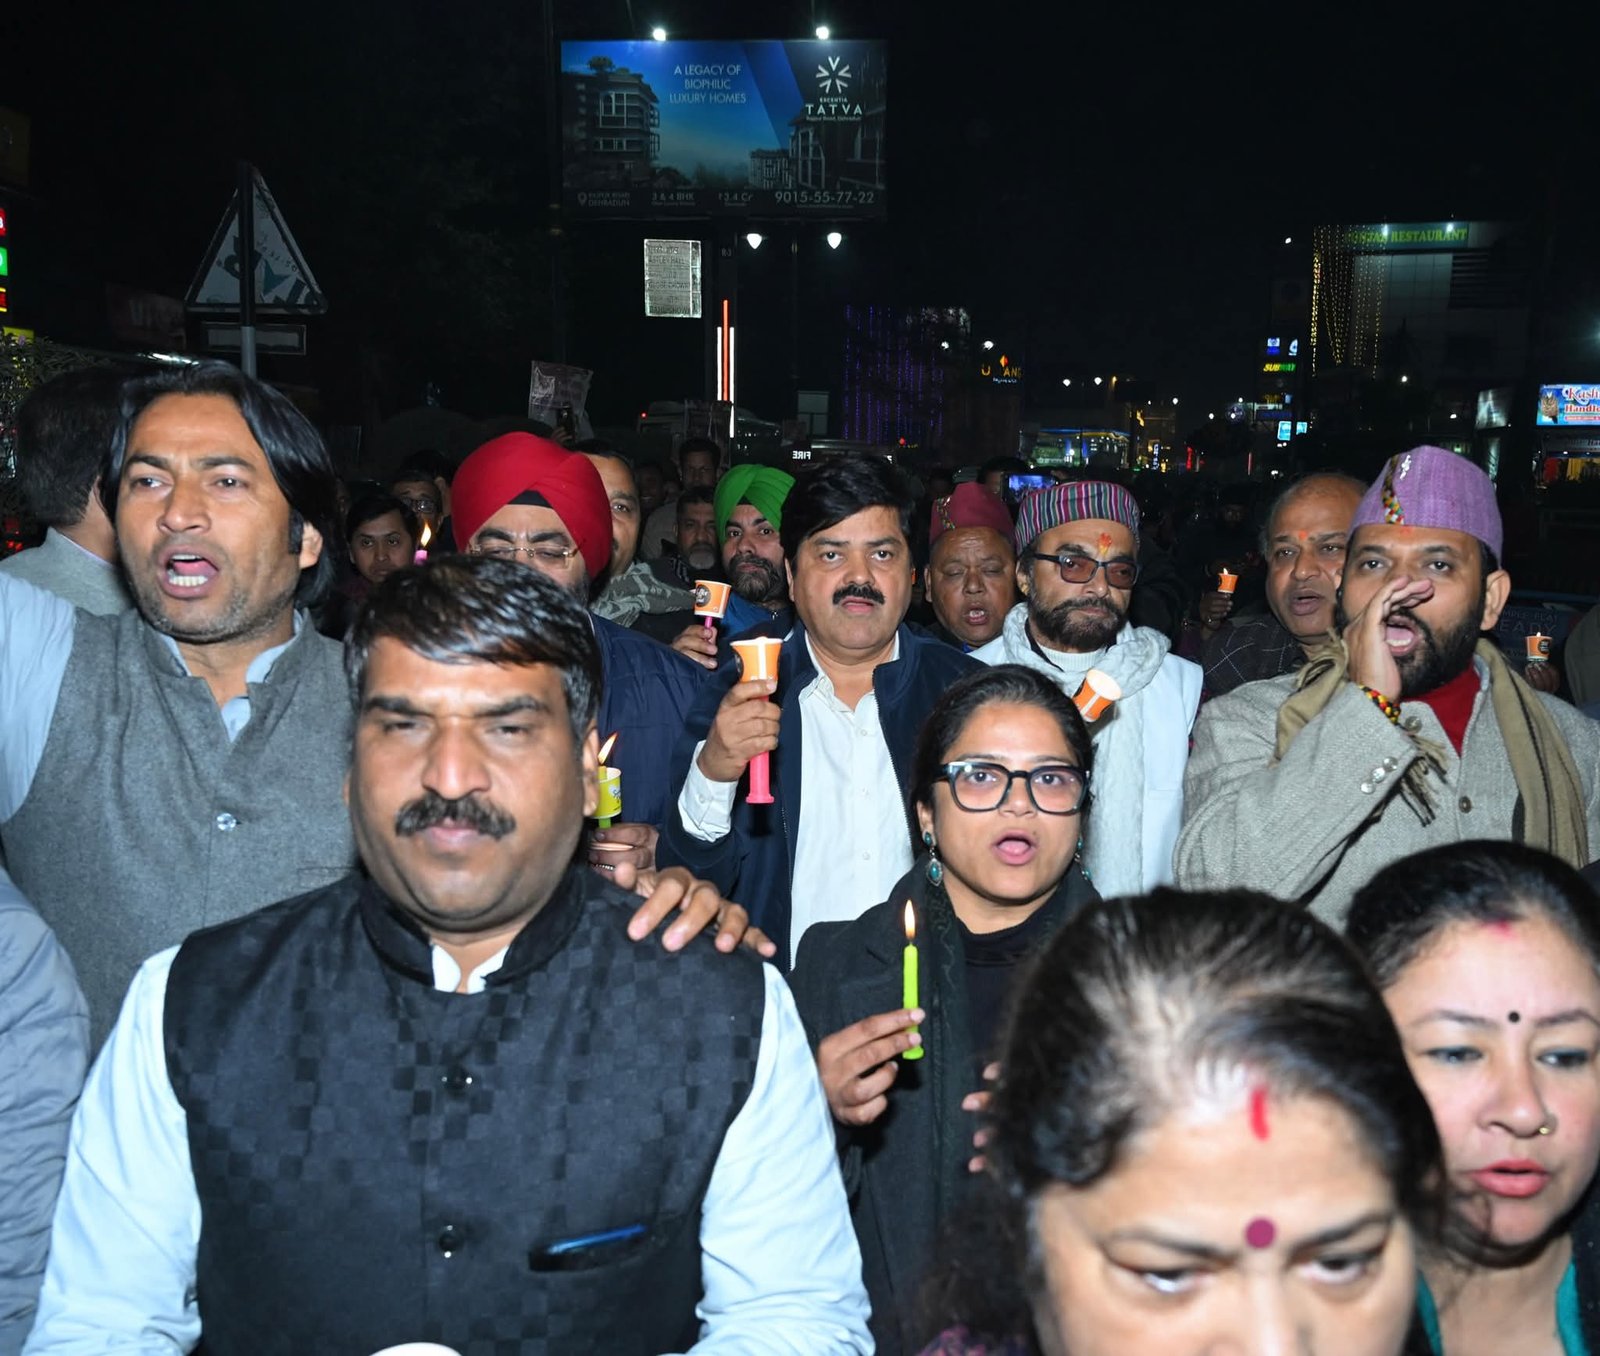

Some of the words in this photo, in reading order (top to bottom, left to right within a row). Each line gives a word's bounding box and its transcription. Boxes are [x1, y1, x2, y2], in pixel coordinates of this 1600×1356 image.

[674, 65, 682, 75] A
[685, 65, 724, 75] LEGACY
[727, 65, 741, 75] OF
[684, 79, 731, 90] BIOPHILIC
[670, 92, 706, 104] LUXURY
[709, 92, 746, 104] HOMES
[805, 104, 863, 115] TATVA
[775, 191, 874, 204] 9015-55-77-22
[1391, 228, 1467, 242] RESTAURANT
[1496, 619, 1557, 635] EADY
